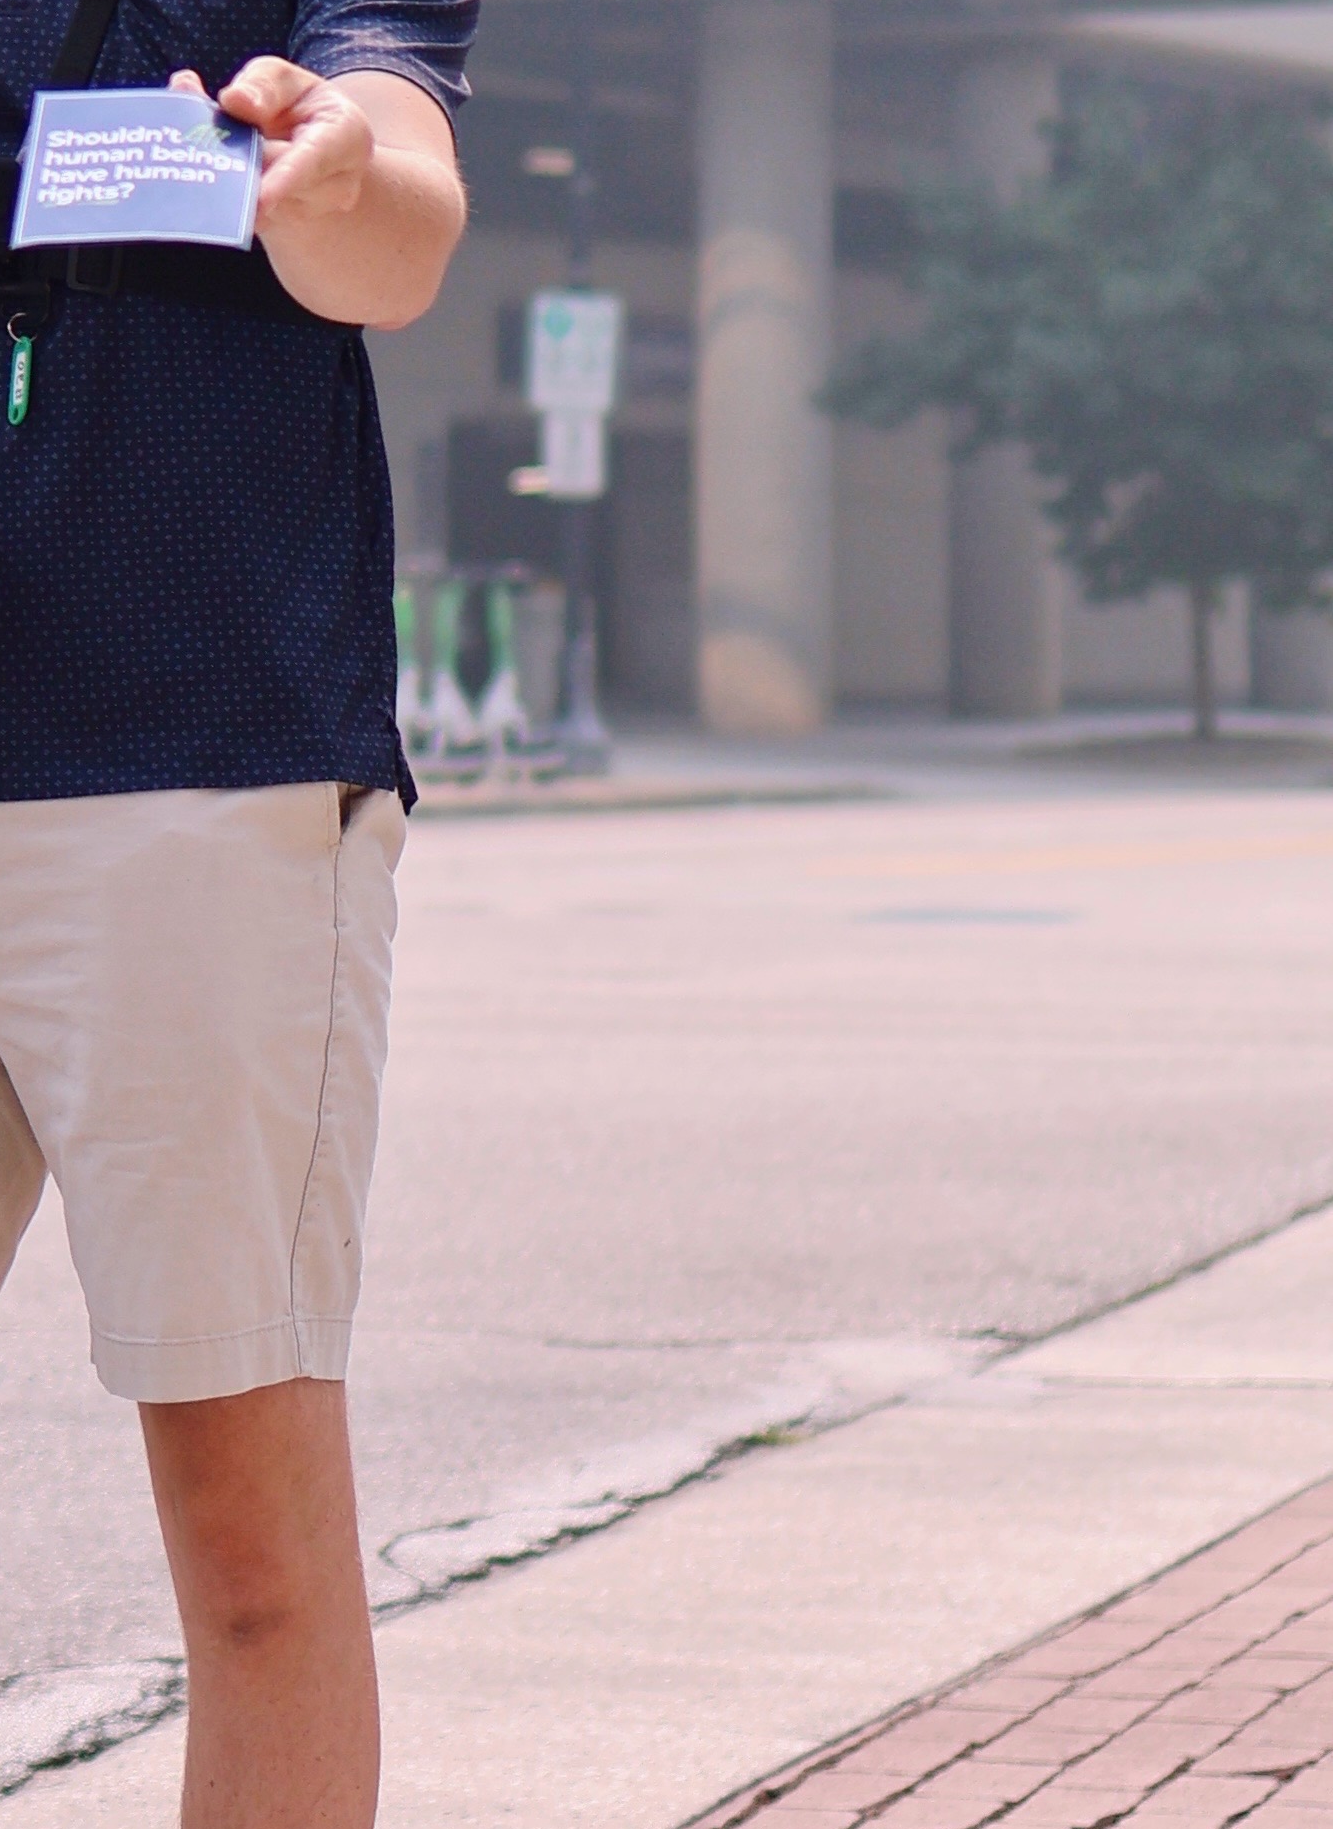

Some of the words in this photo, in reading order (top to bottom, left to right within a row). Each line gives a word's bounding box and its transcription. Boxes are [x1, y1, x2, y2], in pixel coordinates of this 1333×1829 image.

[46, 126, 184, 148] Shouldn't
[43, 146, 145, 166] human
[151, 145, 247, 173] beings
[41, 167, 109, 185] have
[113, 164, 216, 184] human
[37, 182, 136, 206] rights?
